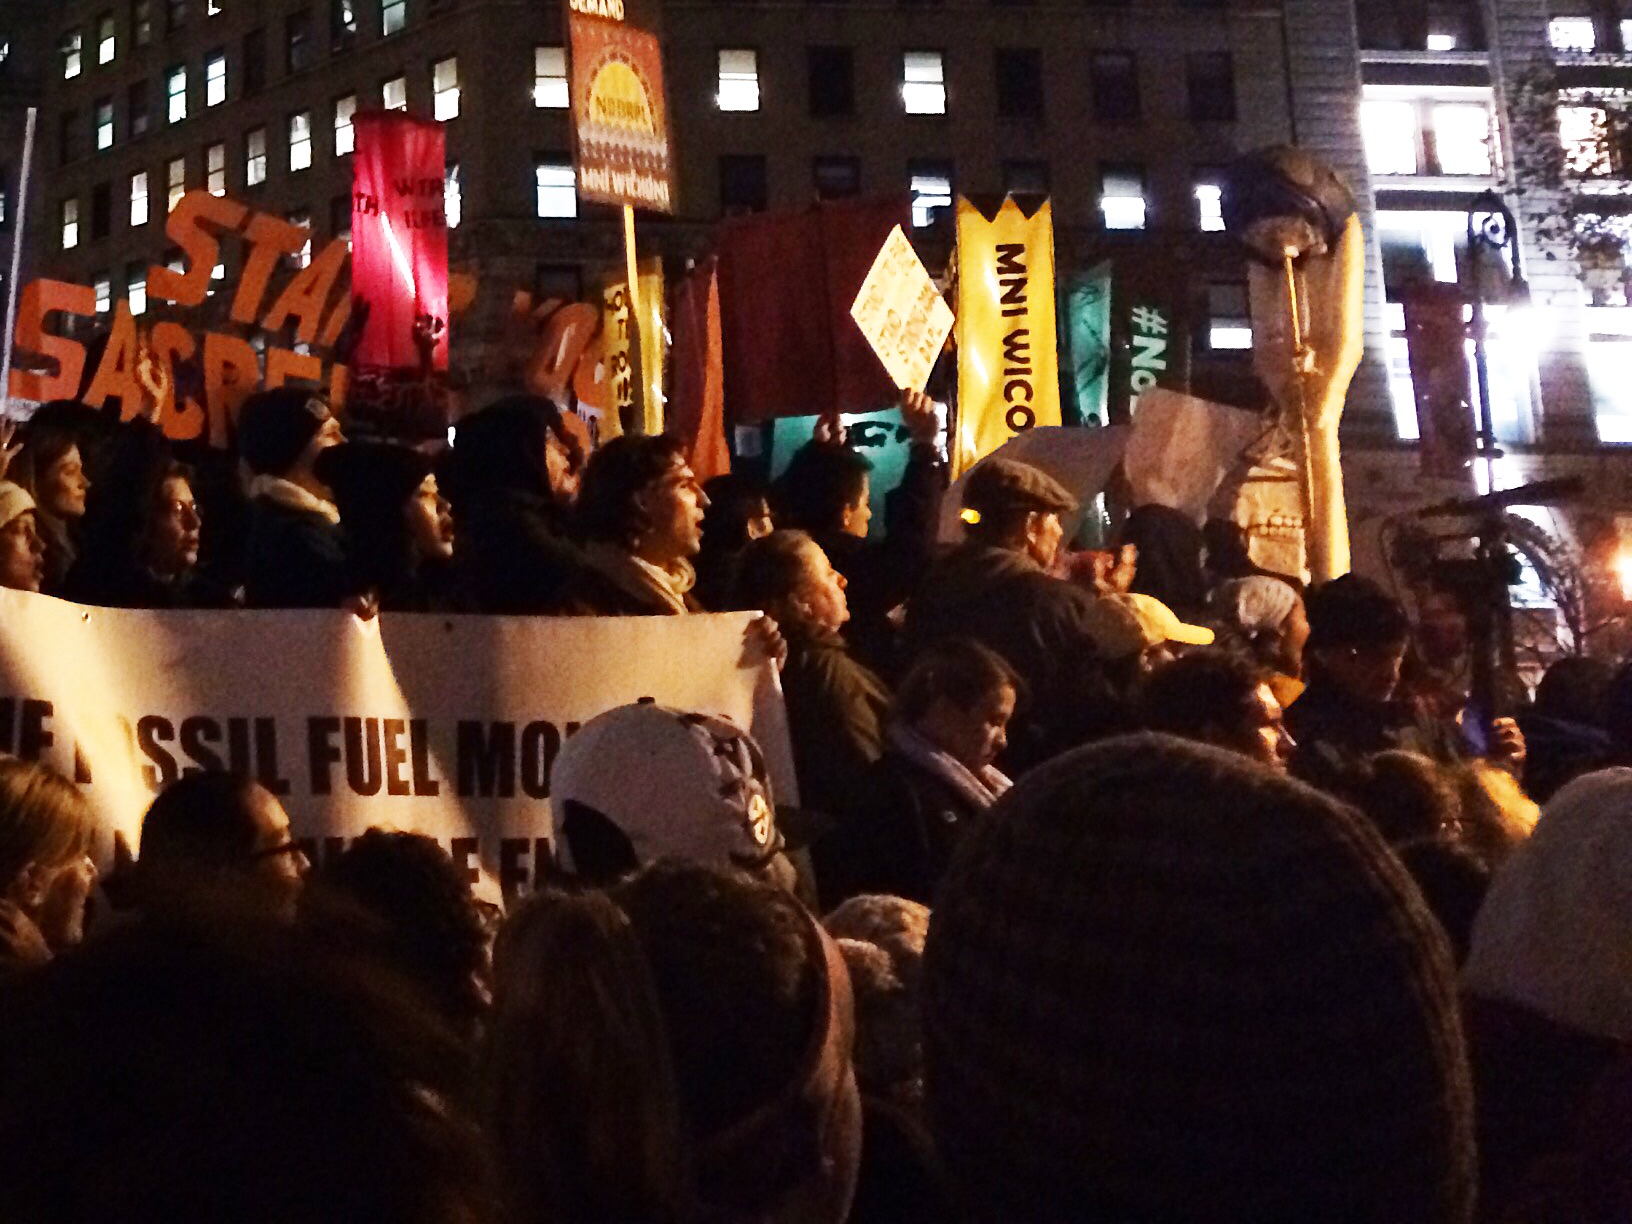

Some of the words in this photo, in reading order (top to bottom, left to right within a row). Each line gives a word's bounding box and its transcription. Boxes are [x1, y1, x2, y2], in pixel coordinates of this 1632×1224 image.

[995, 243, 1028, 318] MNI
[1001, 328, 1037, 434] WICO
[1129, 306, 1168, 418] #No
[74, 712, 291, 795] SSIL
[308, 716, 439, 798] FUEL
